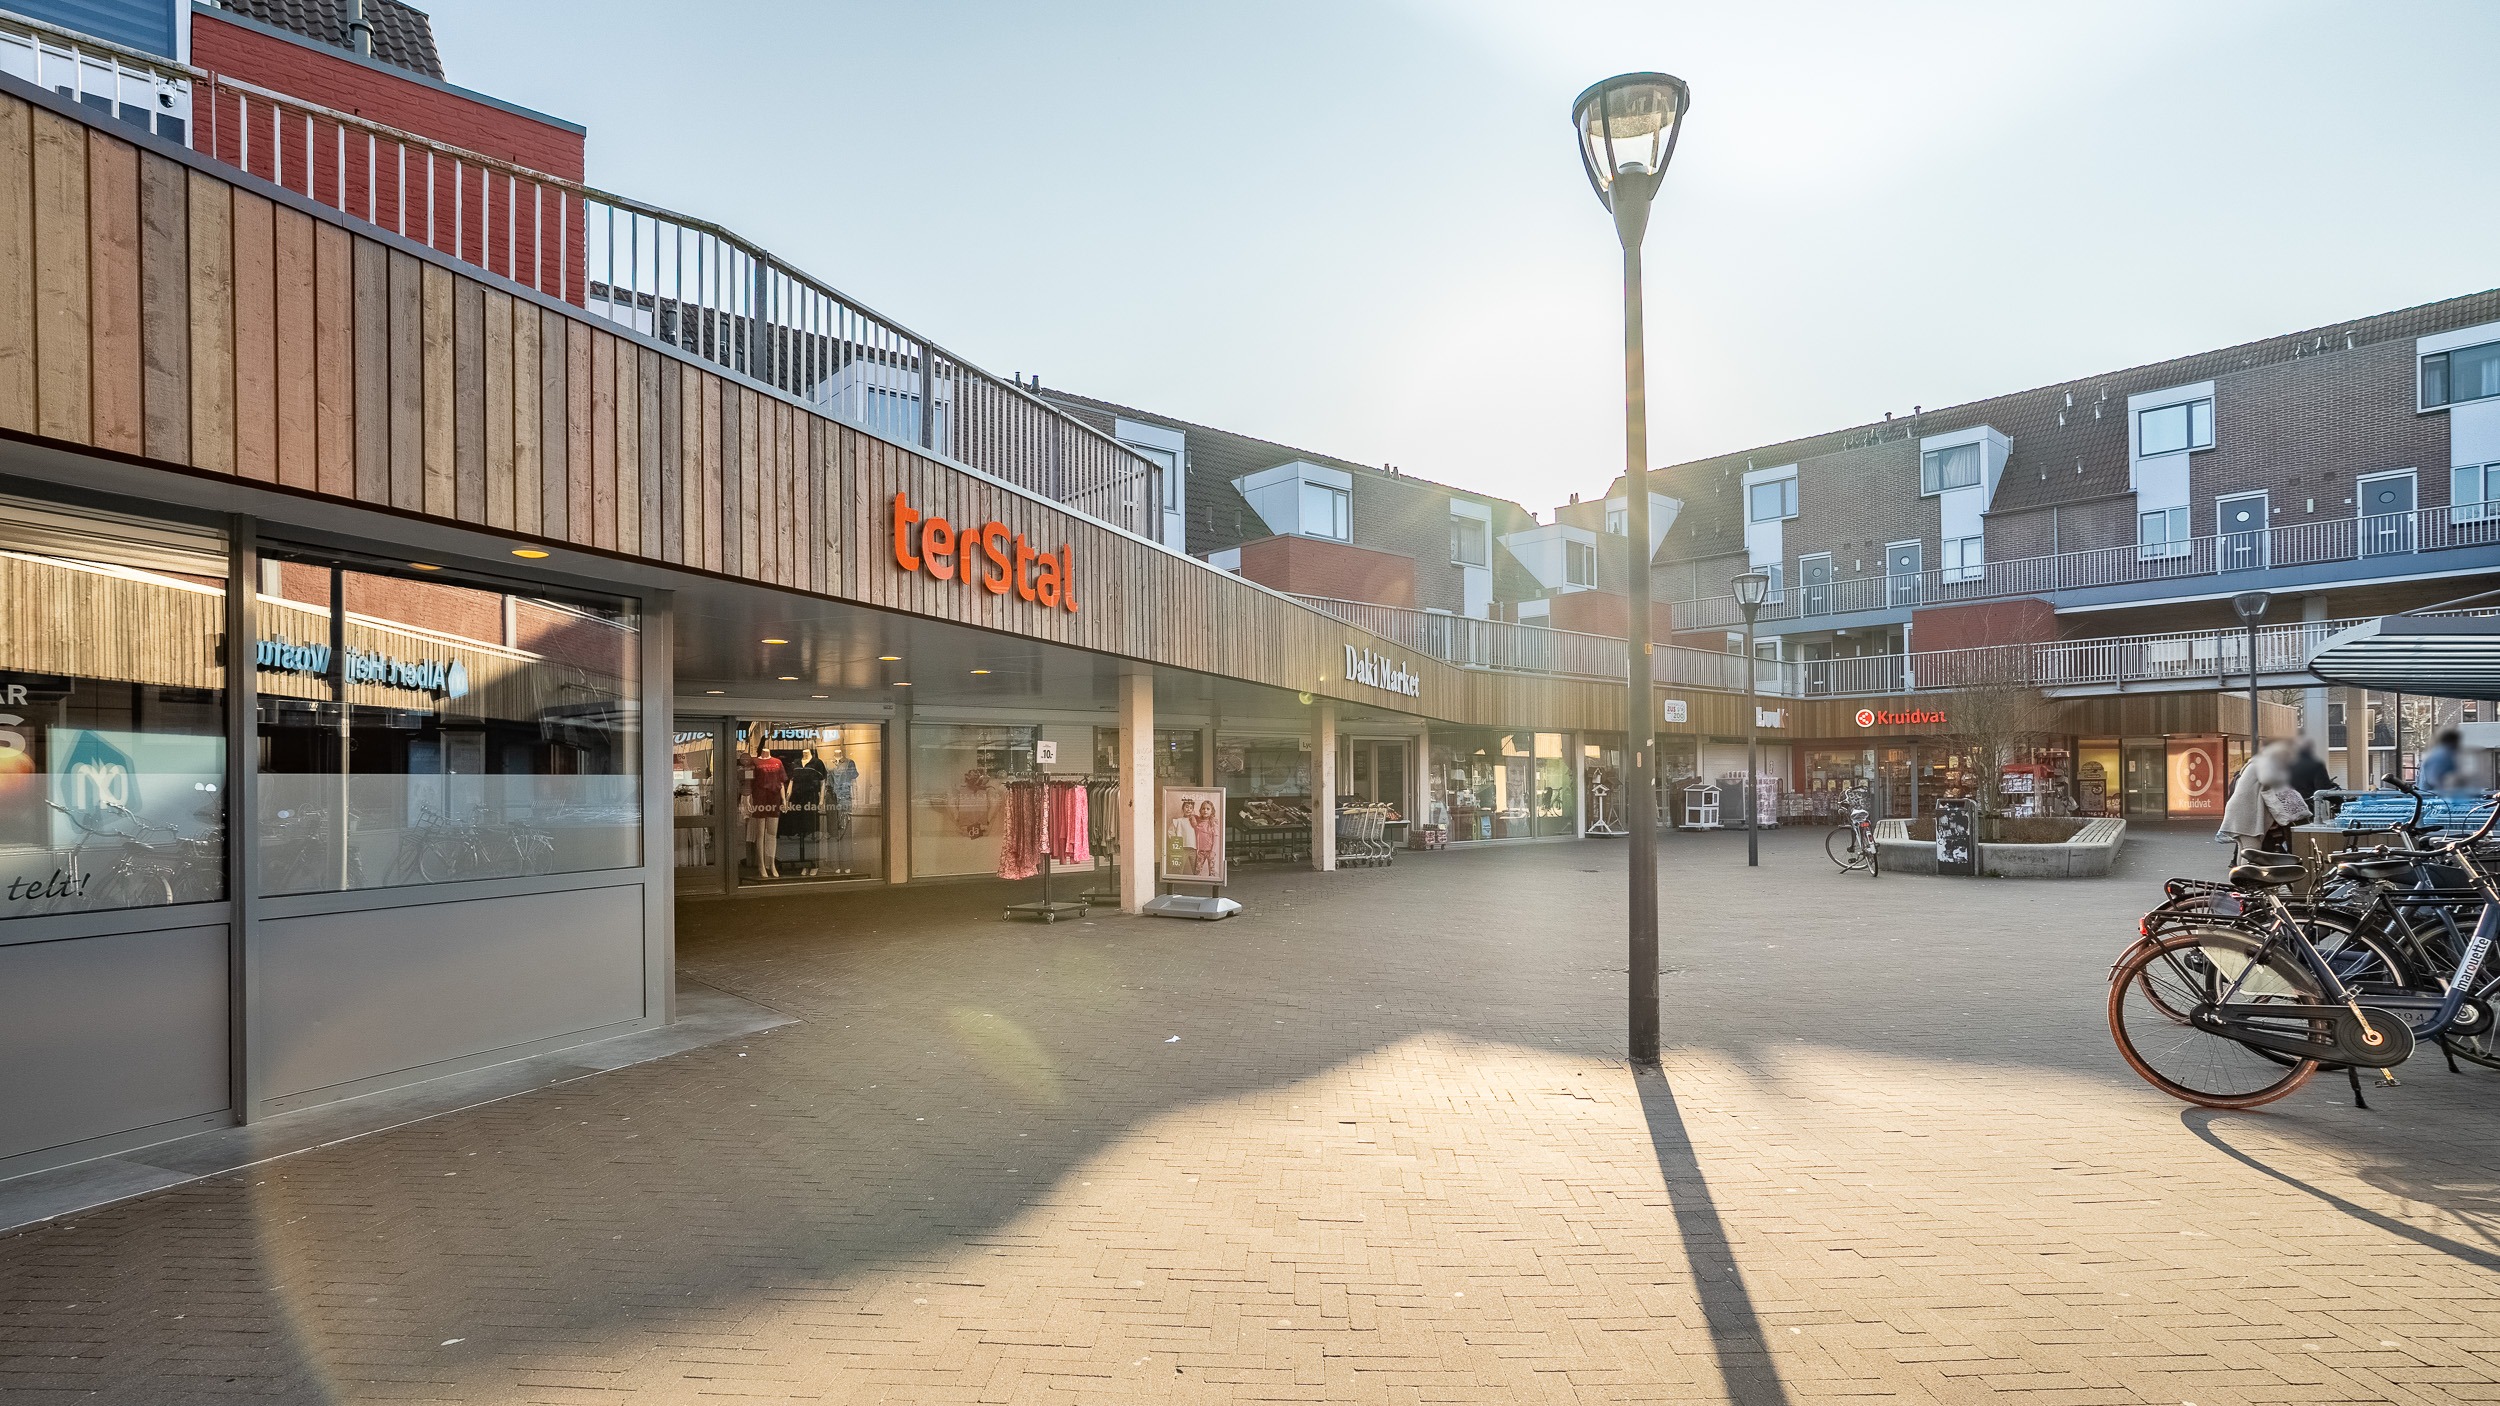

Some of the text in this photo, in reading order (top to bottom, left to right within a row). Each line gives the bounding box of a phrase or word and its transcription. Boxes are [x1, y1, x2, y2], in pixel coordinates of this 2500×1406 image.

[894, 491, 1078, 613] terStal
[1345, 644, 1419, 698] Daki Market
[1877, 708, 1947, 725] Kruidvat
[1302, 741, 1312, 750] Lyc
[2178, 799, 2212, 808] Kruidvat
[8, 868, 91, 901] telt!
